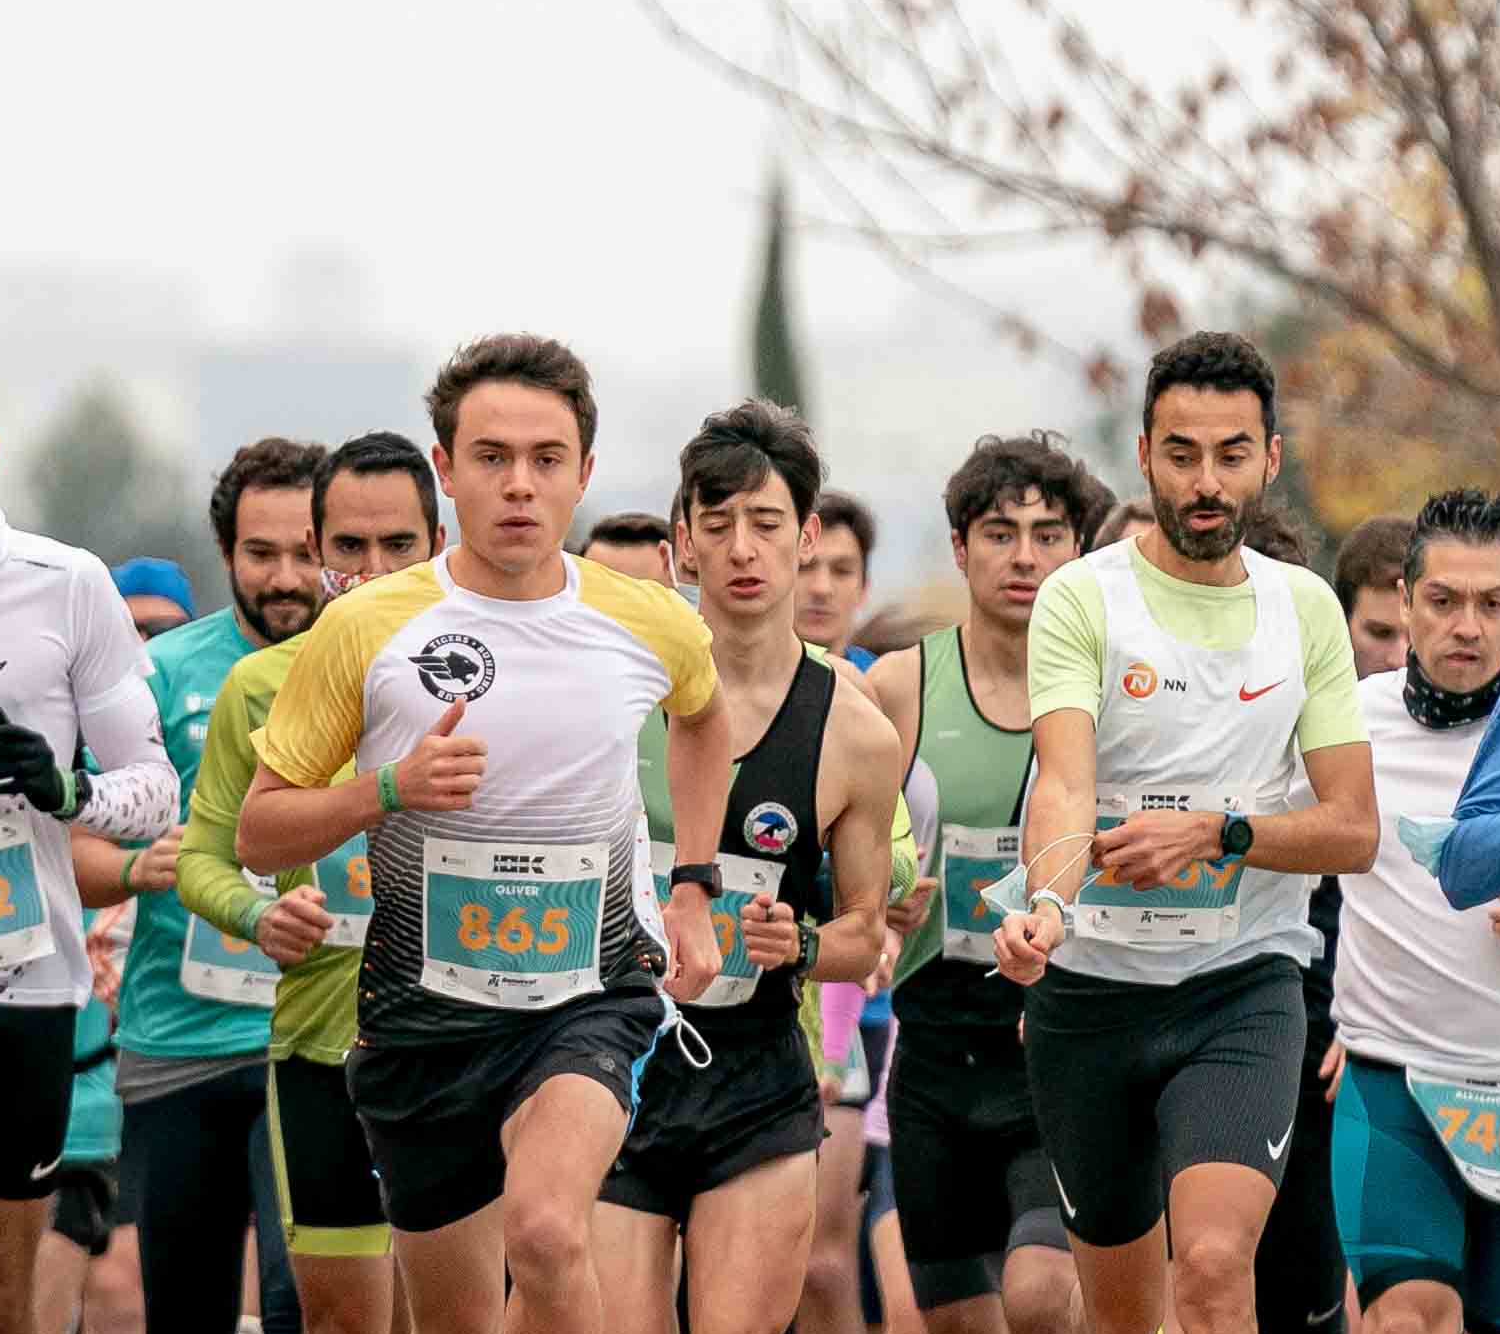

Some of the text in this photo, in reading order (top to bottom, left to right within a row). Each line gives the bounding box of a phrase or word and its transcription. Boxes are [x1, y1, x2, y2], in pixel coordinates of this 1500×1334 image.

[429, 635, 469, 648] TIGERS
[1162, 678, 1187, 692] NN
[492, 853, 546, 875] 10K
[495, 884, 539, 897] OLIVER
[457, 902, 570, 956] 865
